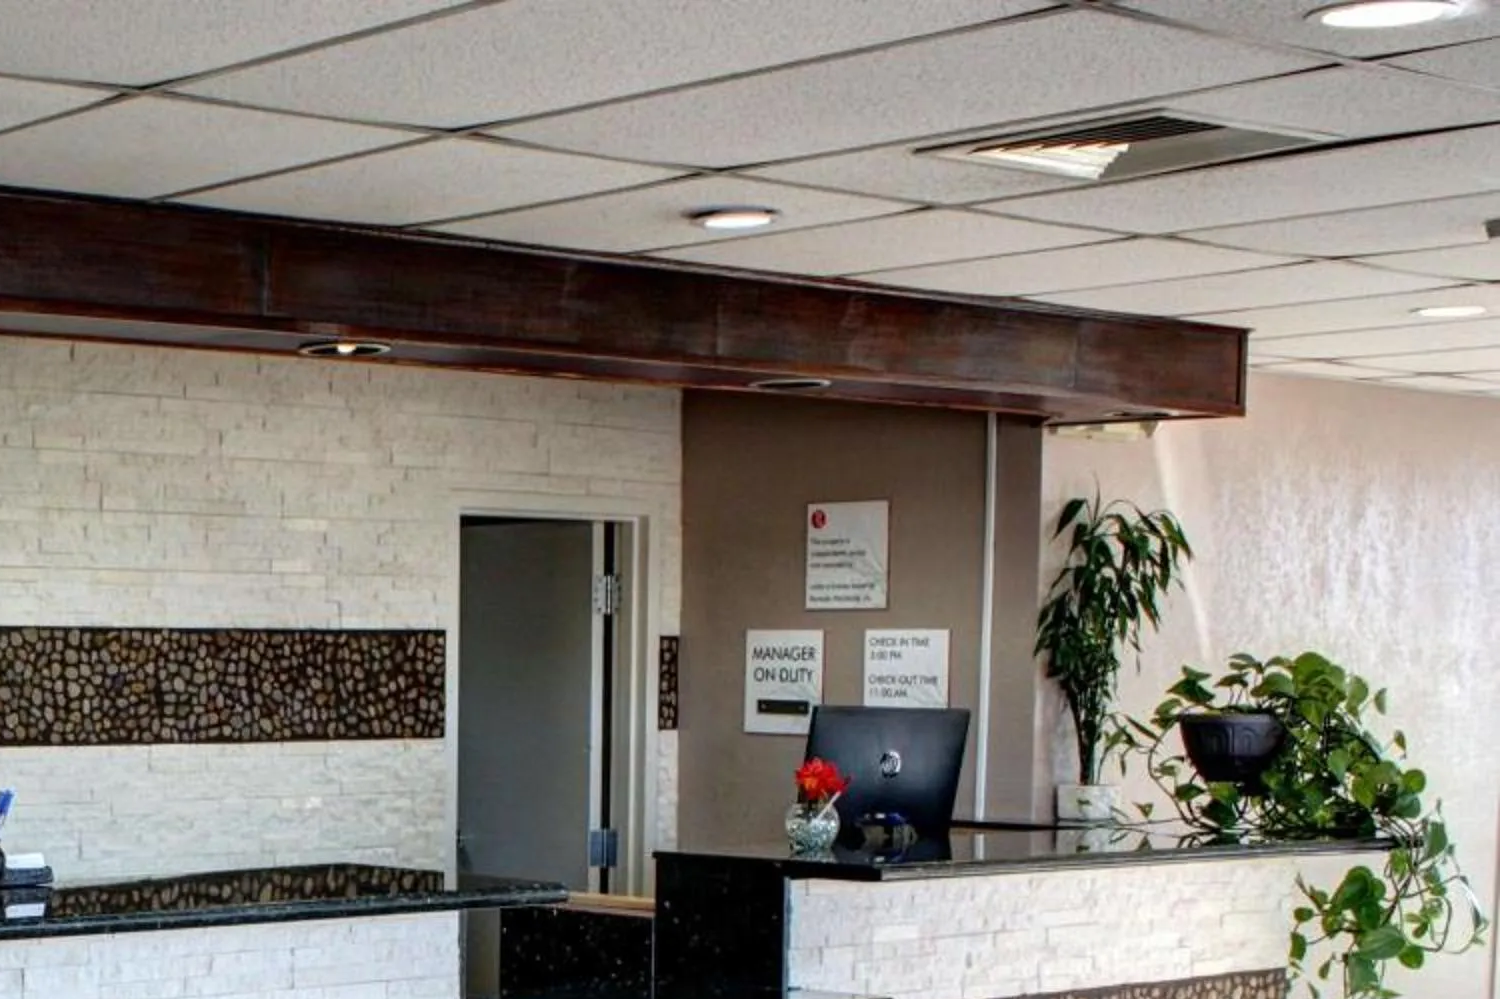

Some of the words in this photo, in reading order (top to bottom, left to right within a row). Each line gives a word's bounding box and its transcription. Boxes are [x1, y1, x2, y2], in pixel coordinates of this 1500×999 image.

[868, 636, 897, 647] CHECK
[752, 645, 816, 661] MANAGER
[753, 666, 776, 682] ON
[779, 666, 814, 682] DUTY
